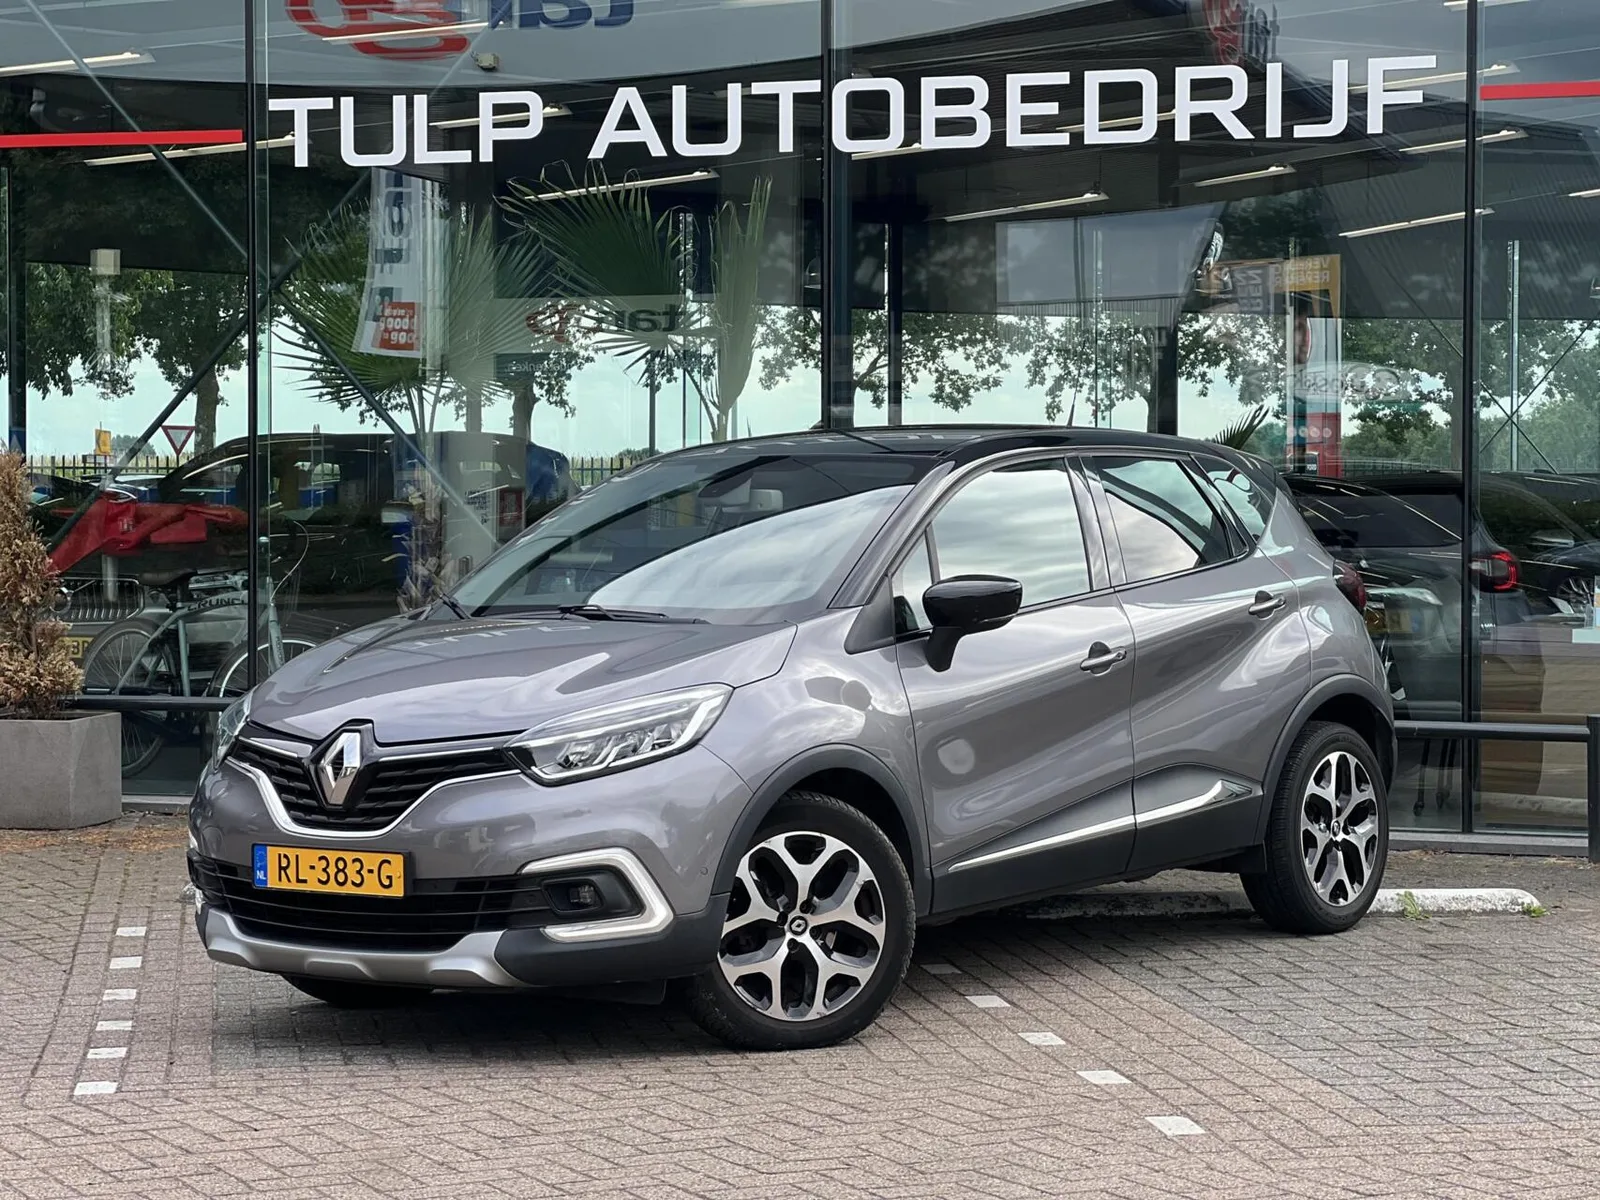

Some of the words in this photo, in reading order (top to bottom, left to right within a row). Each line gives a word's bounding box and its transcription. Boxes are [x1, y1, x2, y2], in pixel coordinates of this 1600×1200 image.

[268, 90, 543, 168] TULP
[587, 54, 1437, 159] AUTOBEDRIJF
[256, 870, 266, 880] NL
[277, 852, 393, 889] RL-383-G
